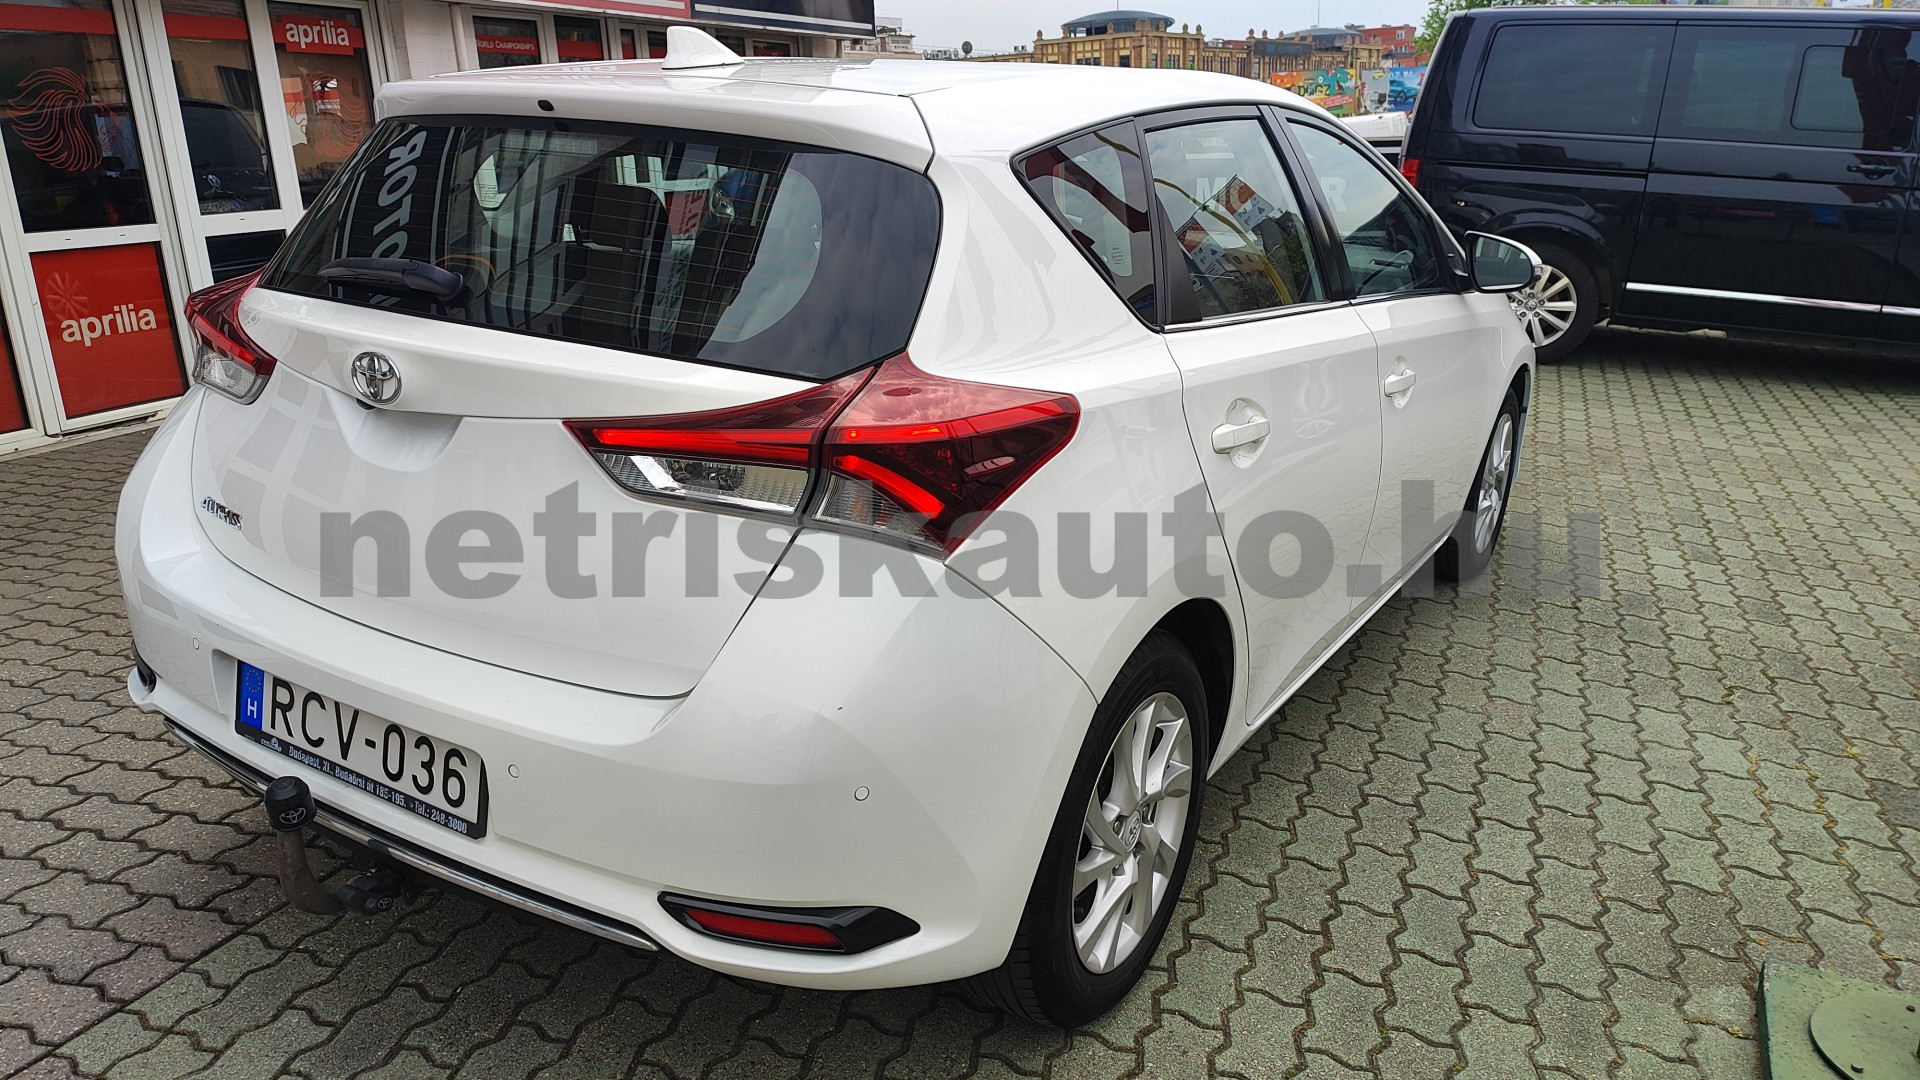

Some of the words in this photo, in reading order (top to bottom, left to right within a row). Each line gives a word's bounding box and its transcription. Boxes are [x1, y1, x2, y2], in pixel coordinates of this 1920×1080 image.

[285, 20, 350, 49] aprilia
[60, 303, 158, 347] aprilia
[247, 697, 258, 719] H
[270, 675, 468, 809] RCV-036
[288, 746, 321, 770] Budapest,
[375, 784, 407, 808] 185-195.
[430, 809, 467, 834] 248-3000
